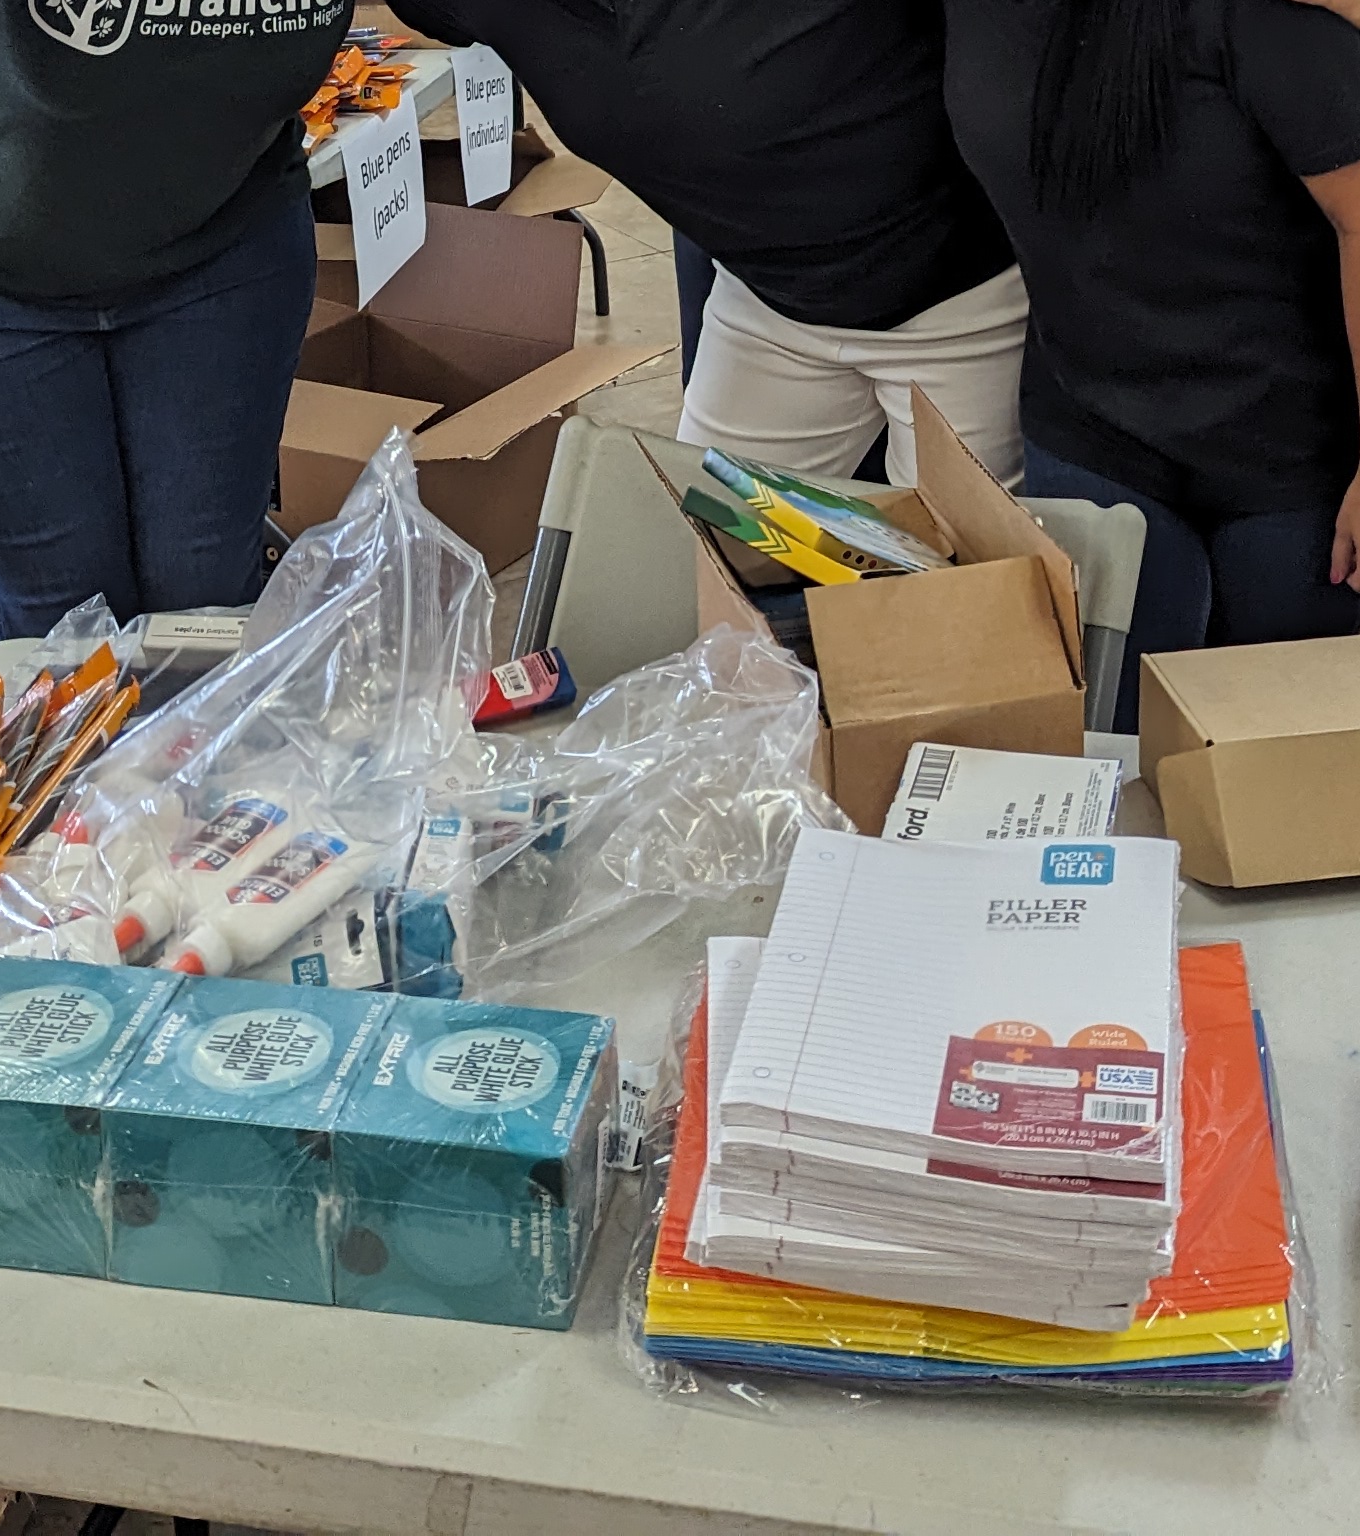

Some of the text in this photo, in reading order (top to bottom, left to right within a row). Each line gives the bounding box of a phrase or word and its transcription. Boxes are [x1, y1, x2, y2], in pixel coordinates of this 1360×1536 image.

[139, 19, 183, 37] Grow
[189, 20, 255, 39] Deeper,
[262, 14, 307, 35] Climb
[465, 75, 506, 104] Blue pens
[465, 116, 509, 157] (individual)
[360, 131, 412, 190] Blue pens
[372, 179, 410, 241] (packs)
[1053, 862, 1104, 878] GEAR
[985, 911, 1082, 925] PAPER
[987, 898, 1089, 912] FILLER
[17, 991, 86, 1059] WHITE GLUE
[56, 1011, 100, 1045] STICK
[993, 1023, 1038, 1038] 150
[1090, 1029, 1128, 1039] Wide
[205, 1032, 241, 1054] ALL
[221, 1019, 273, 1072] PURPOSE
[241, 1014, 303, 1081] WHITE GLUE
[278, 1033, 321, 1067] STICK
[1087, 1038, 1129, 1047] Ruled
[432, 1053, 463, 1076] ALL
[451, 1040, 496, 1093] PURPOSE
[472, 1036, 526, 1103] WHITE GLUE
[507, 1056, 544, 1090] STICK
[1098, 1073, 1134, 1085] USA
